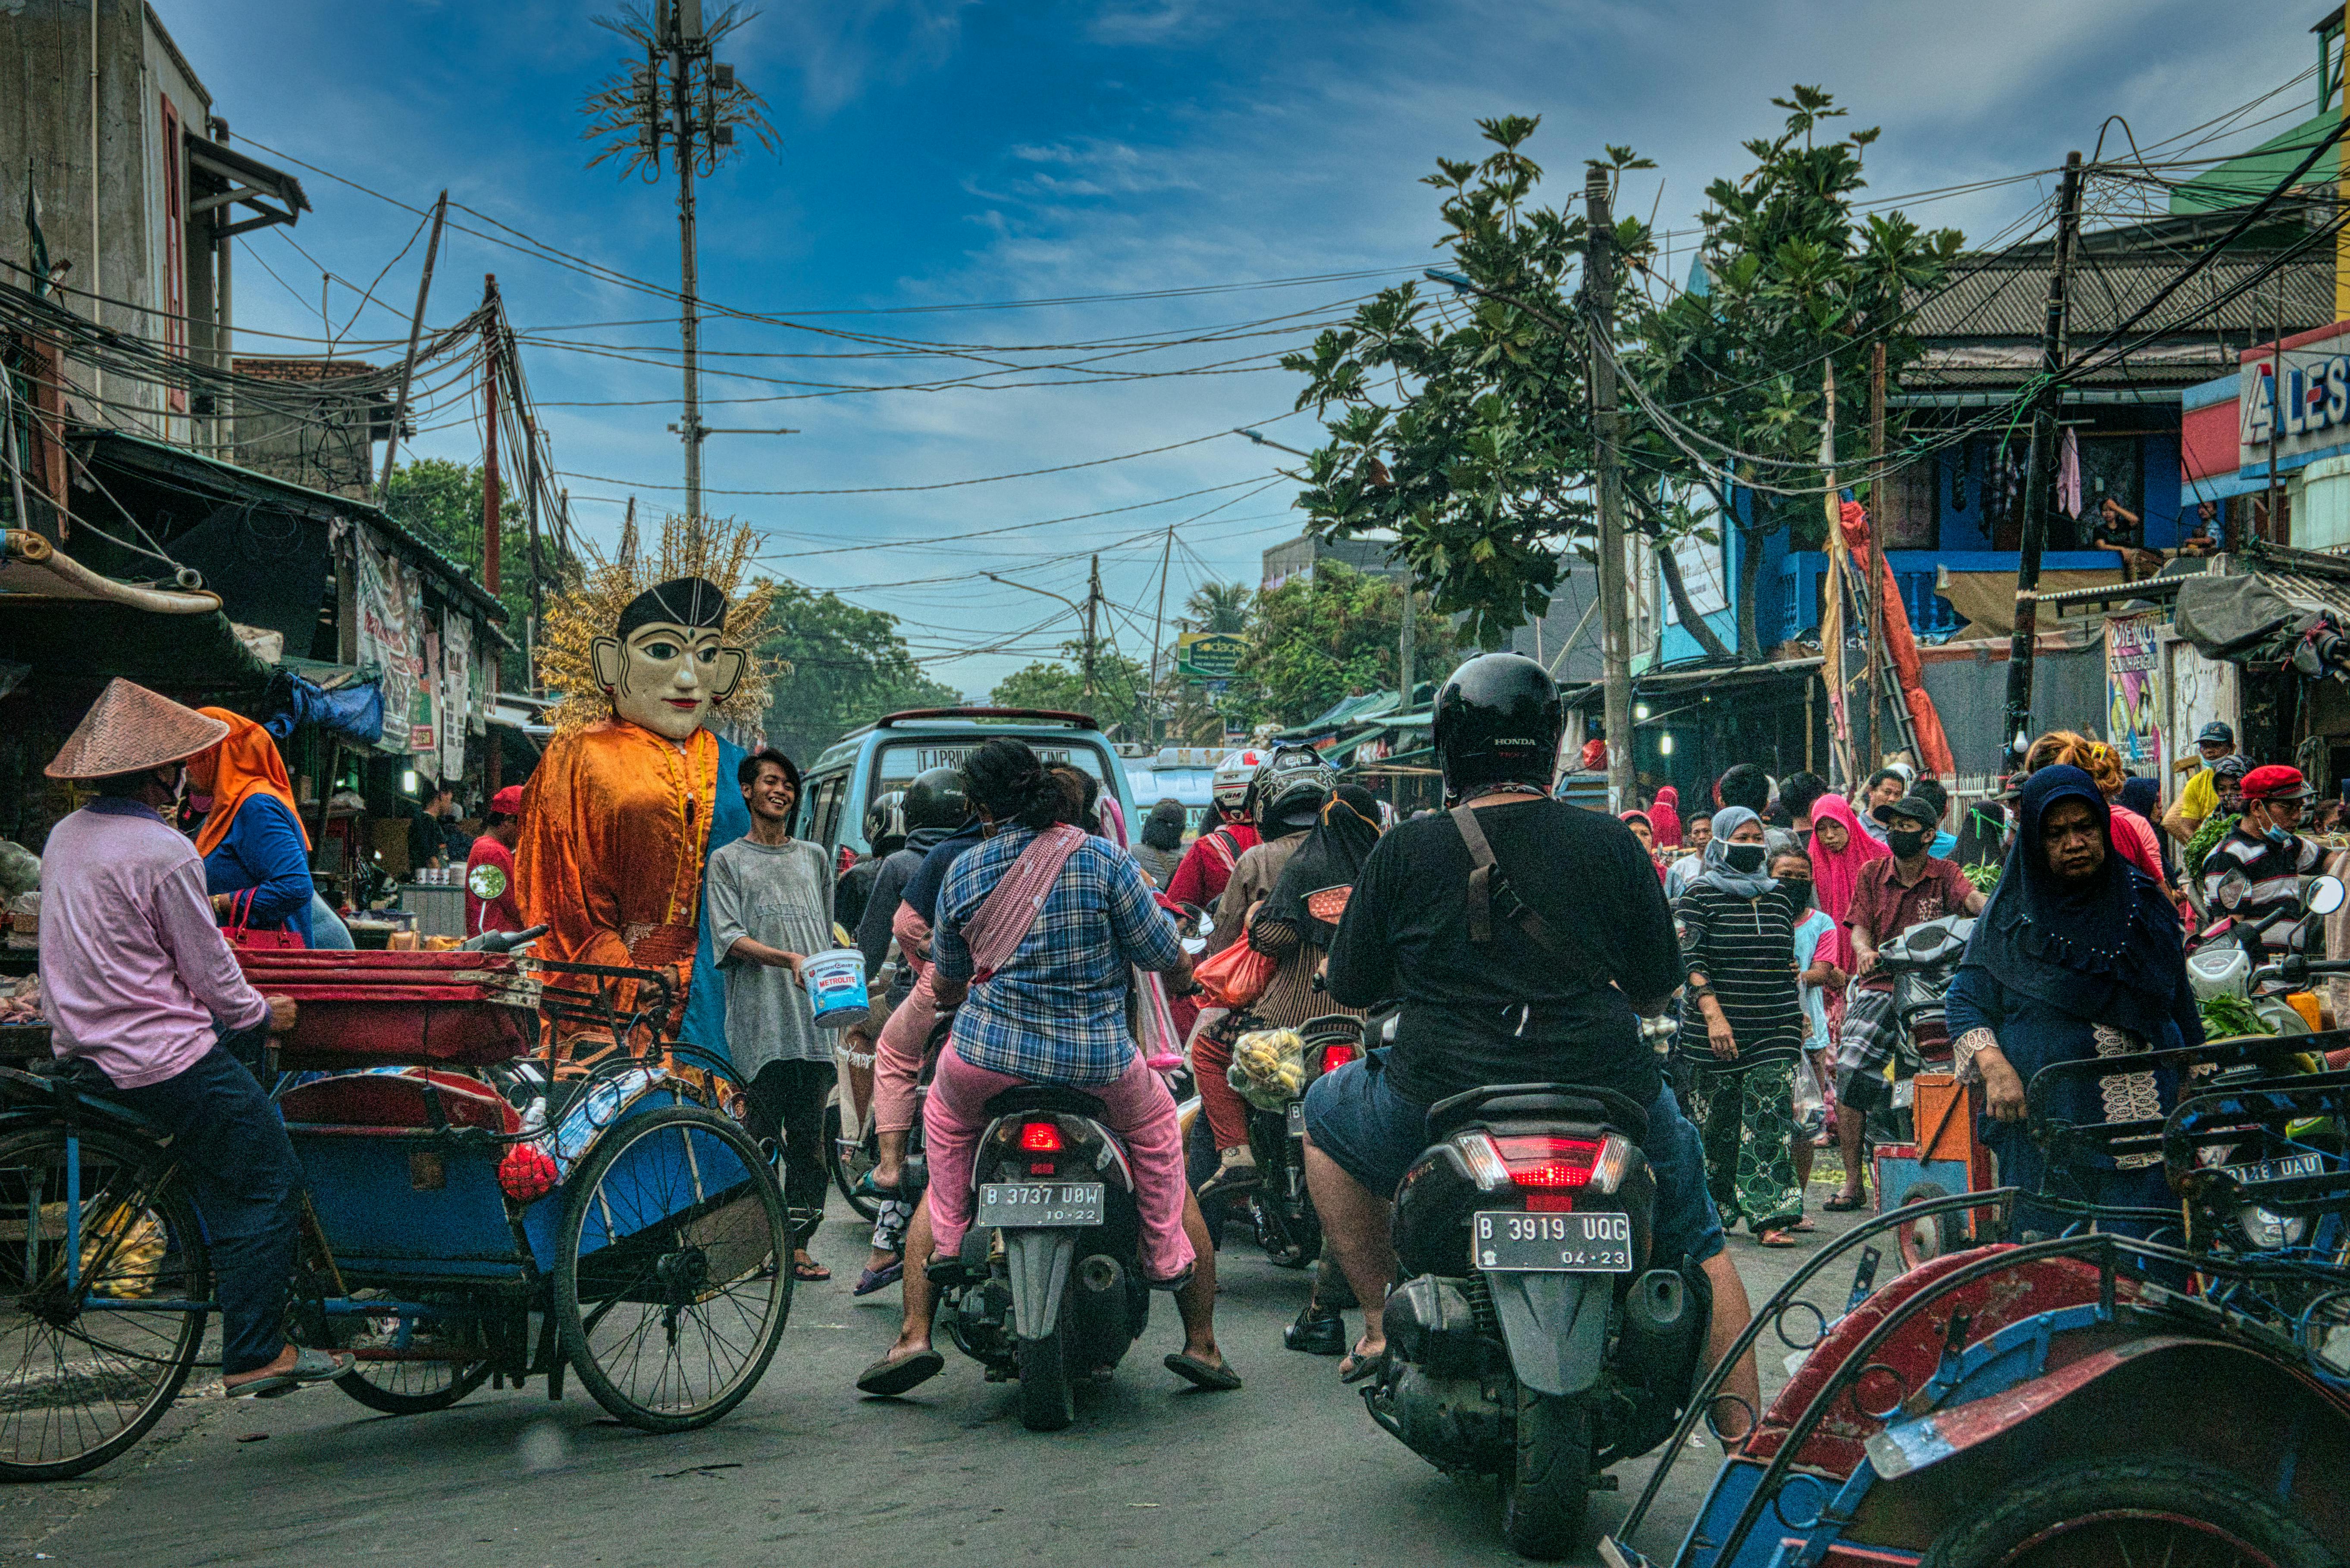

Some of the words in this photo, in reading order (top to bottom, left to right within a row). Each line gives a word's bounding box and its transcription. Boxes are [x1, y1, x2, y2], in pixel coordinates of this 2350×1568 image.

[2241, 357, 2350, 445] ALES
[2112, 618, 2153, 648] MENU
[819, 976, 856, 988] METROLITE
[2224, 1064, 2257, 1074] SUZUKI
[2280, 1157, 2316, 1176] UAU
[1007, 1188, 1053, 1205] 3737
[1480, 1217, 1493, 1239] B
[1509, 1217, 1566, 1240] 3919
[1583, 1217, 1627, 1240] UQG
